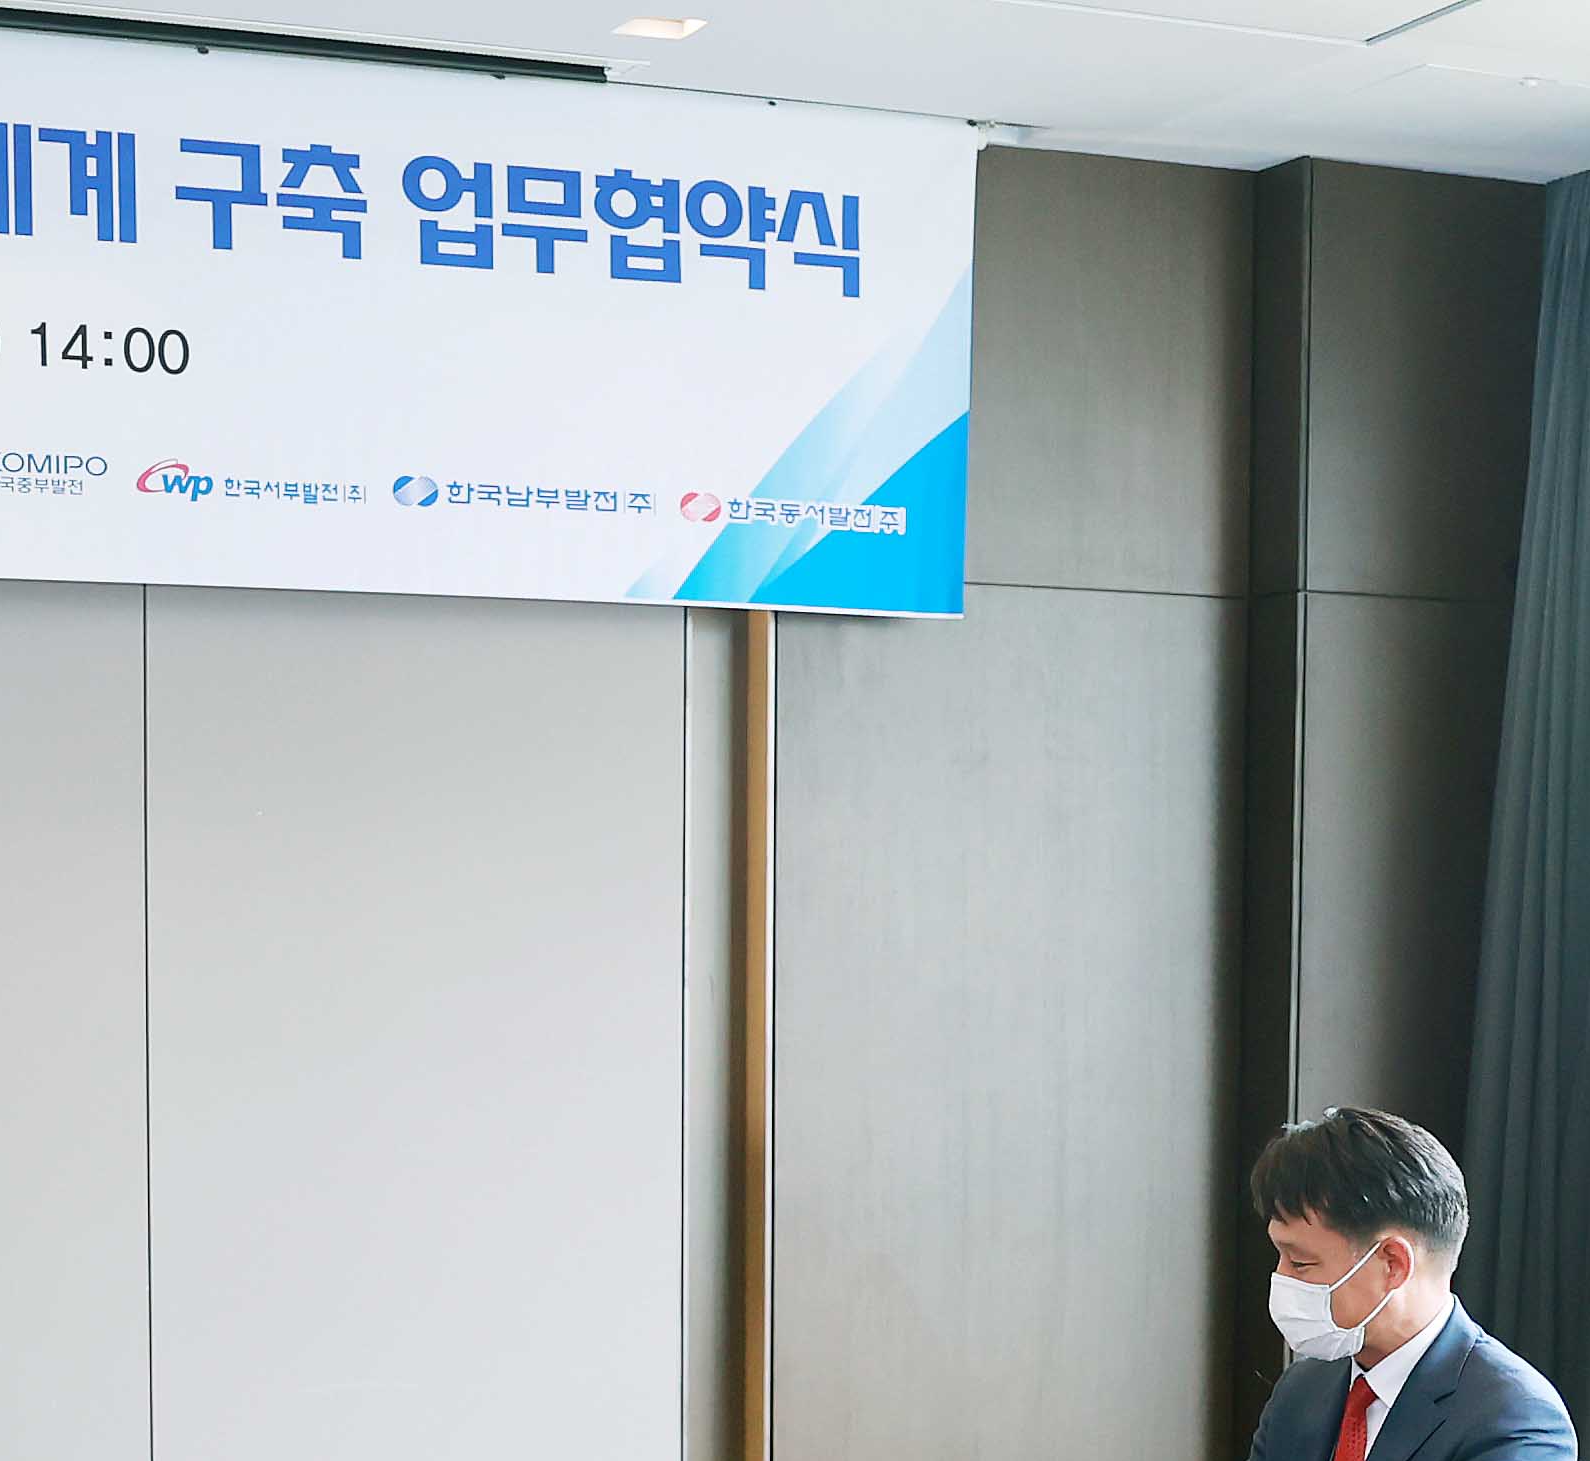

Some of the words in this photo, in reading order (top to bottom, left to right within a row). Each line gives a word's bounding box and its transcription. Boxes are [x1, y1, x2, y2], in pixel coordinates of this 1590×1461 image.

[175, 138, 368, 260] 구축
[402, 153, 860, 298] 업무협약식
[31, 321, 190, 375] 14:00
